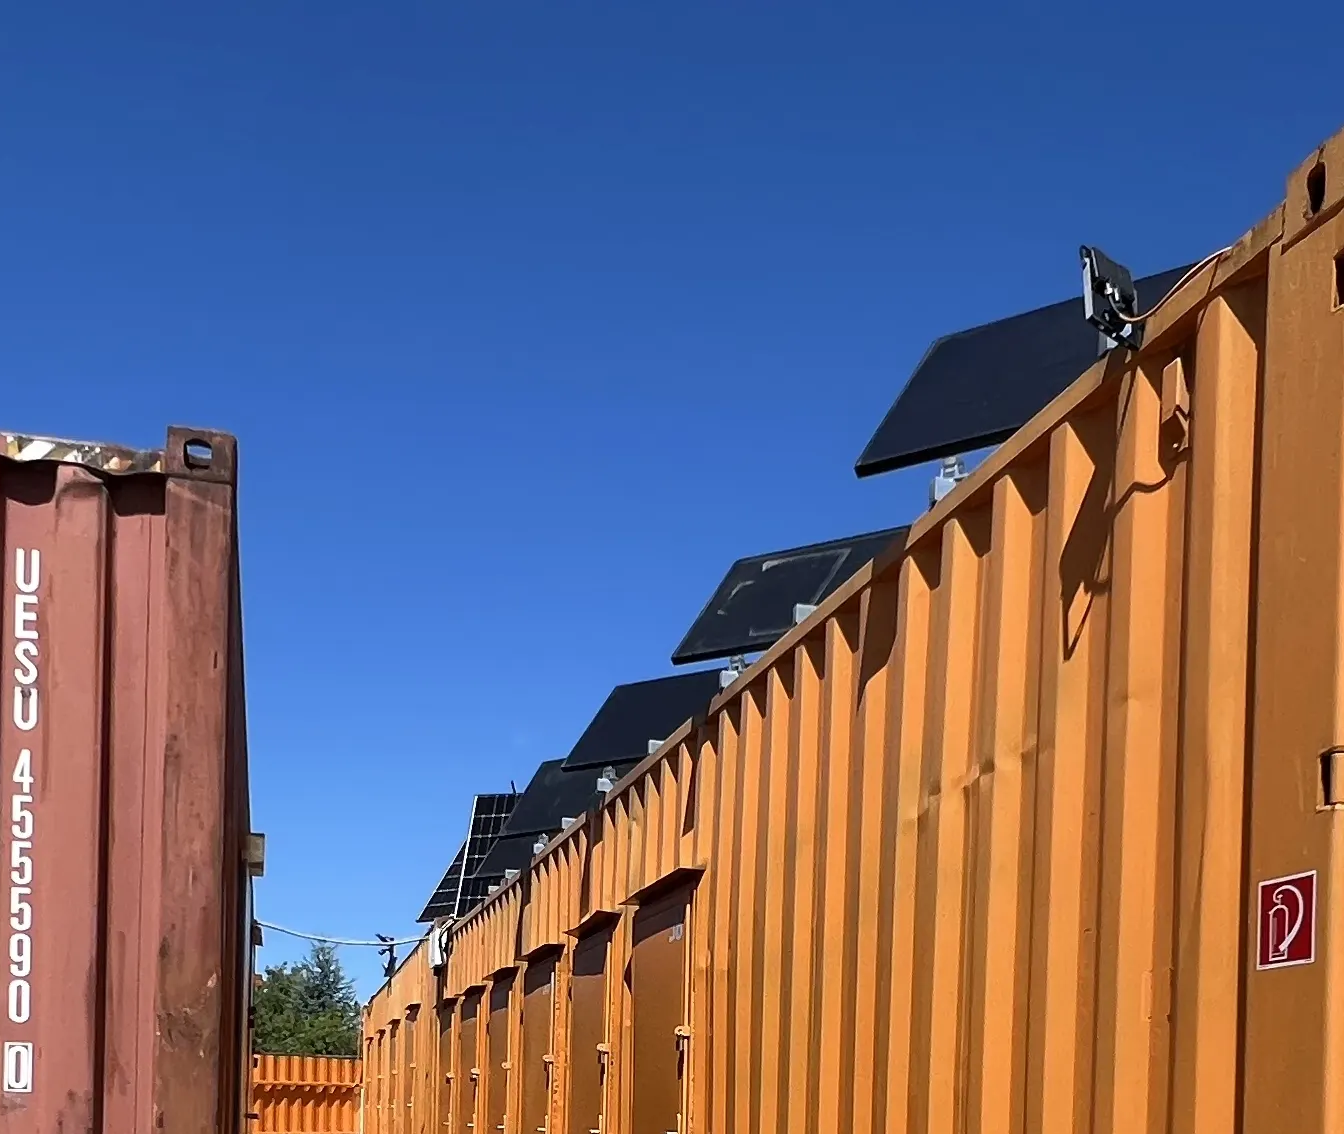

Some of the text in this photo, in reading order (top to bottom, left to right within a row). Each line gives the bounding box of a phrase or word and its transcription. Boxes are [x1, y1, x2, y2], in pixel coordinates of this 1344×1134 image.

[6, 547, 41, 1091] UESU 455590 0
